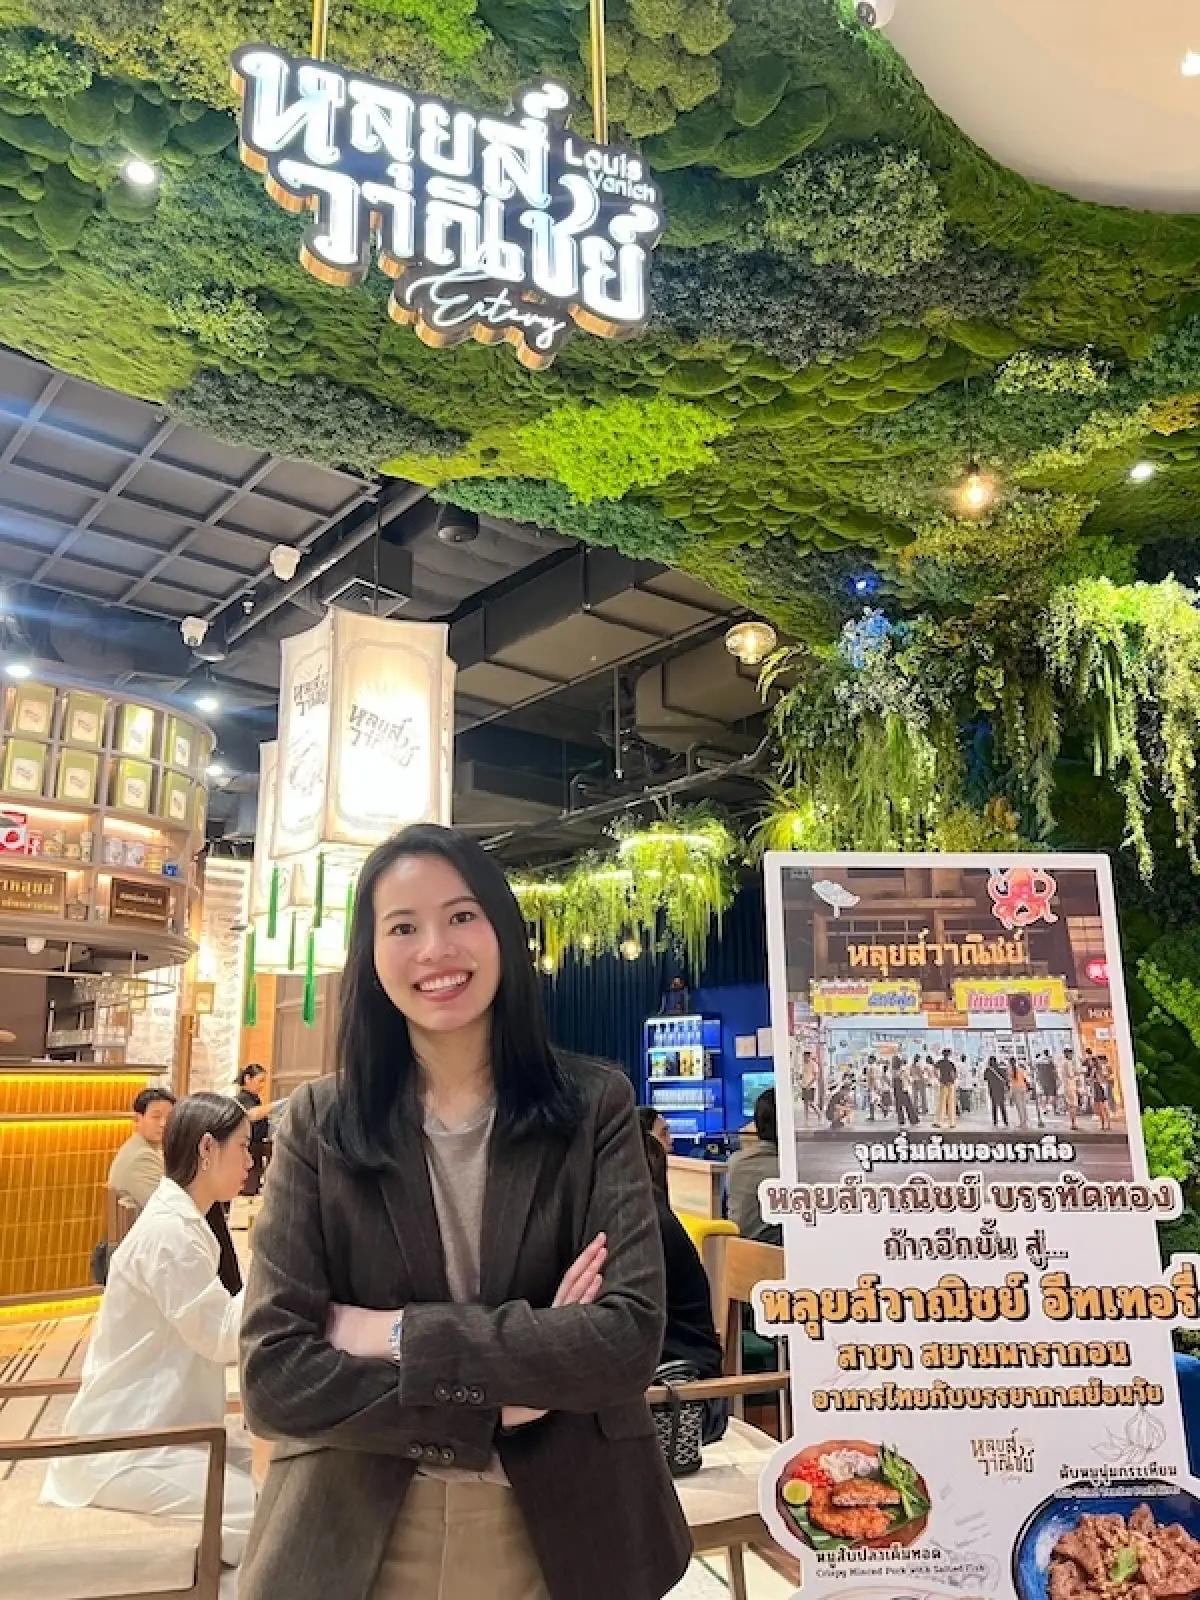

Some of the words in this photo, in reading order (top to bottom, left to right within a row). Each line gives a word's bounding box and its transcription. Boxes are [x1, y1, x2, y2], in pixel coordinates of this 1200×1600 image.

[239, 50, 569, 208] หลุยส์
[564, 137, 642, 181] Louis
[588, 168, 657, 203] Vanich
[277, 159, 660, 321] วาณิชย์
[848, 928, 1025, 977] หลุยส์วาณิชย์
[854, 1132, 1075, 1171] จุดเริ่มต้นของเราคือ
[766, 1173, 981, 1225] หลุยส์วาณิชย์
[989, 1173, 1175, 1211] บรรทัดทอง
[884, 1218, 1018, 1261] ก้าวอีกขั้น
[760, 1272, 1029, 1339] หลุยส์วาณิชย์
[1040, 1262, 1200, 1321] อีทเทอรี่
[837, 1343, 912, 1371] สาขา
[920, 1341, 1131, 1369] สยามพารากอน
[812, 1376, 1164, 1412] อาหารไทยกับบรรยากาศย้อนวัย
